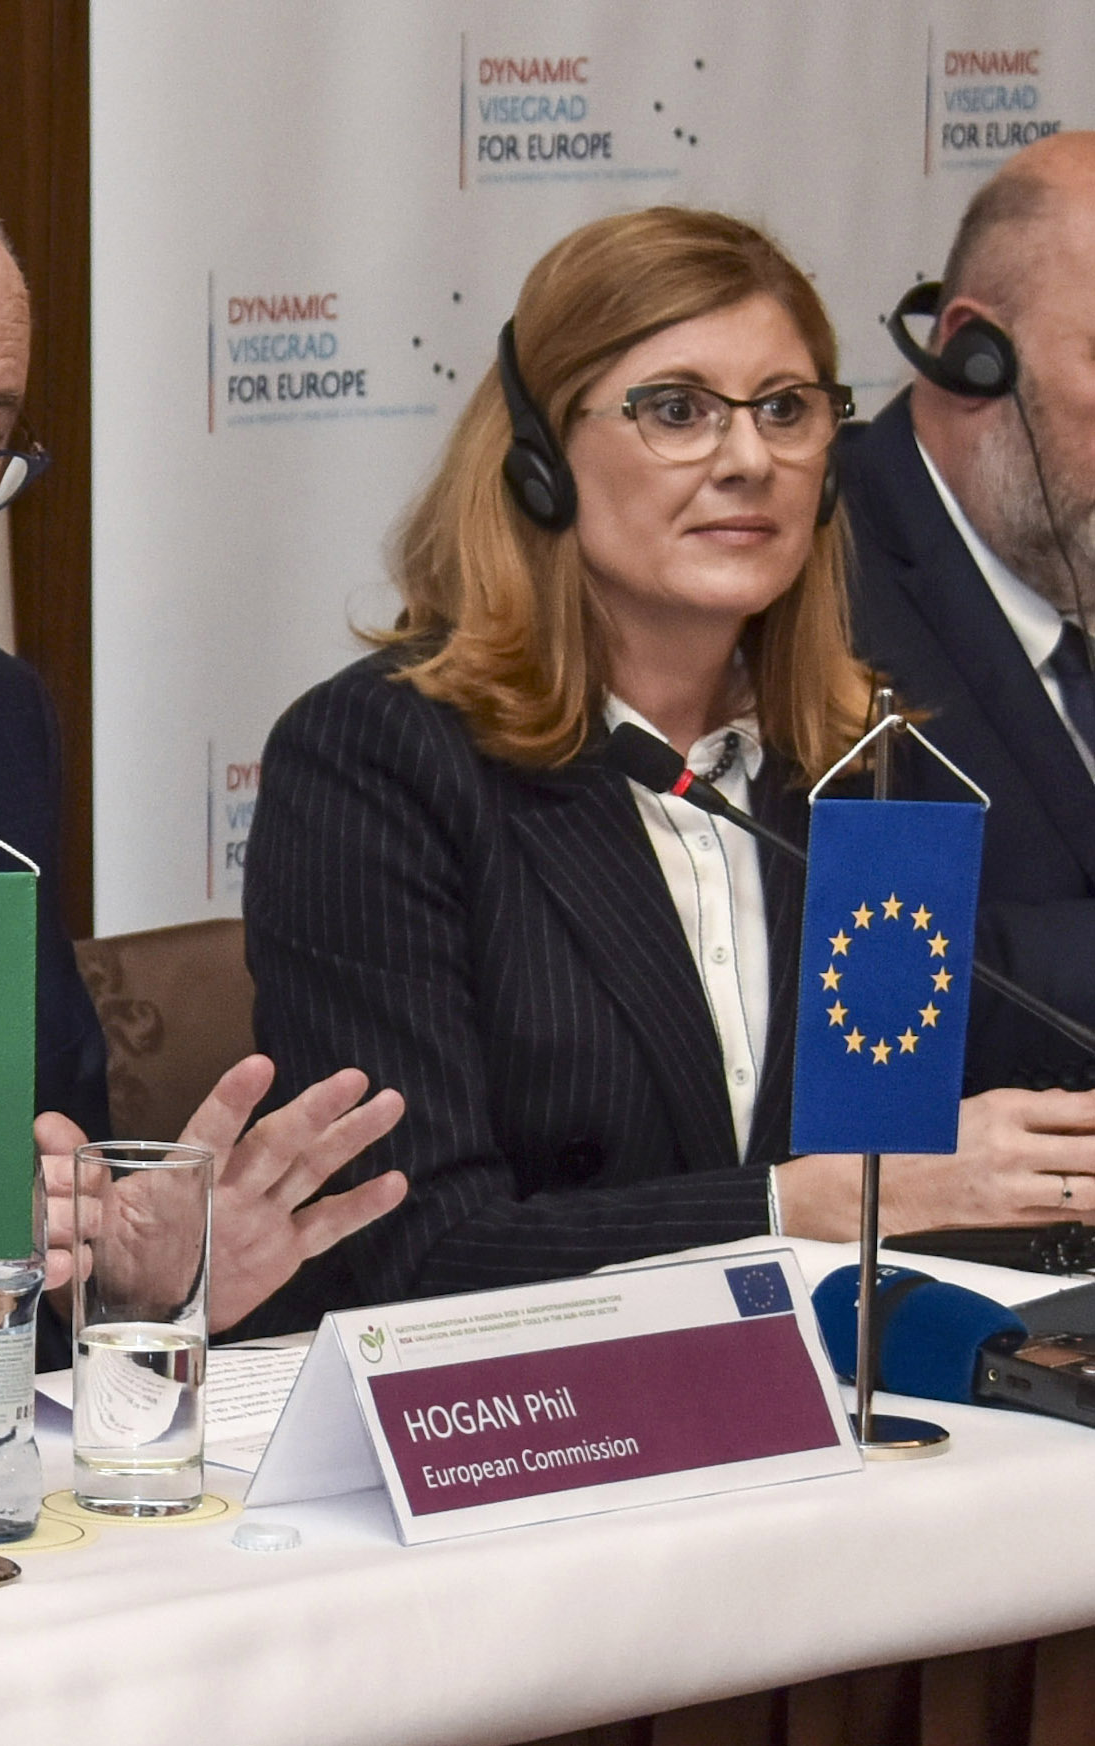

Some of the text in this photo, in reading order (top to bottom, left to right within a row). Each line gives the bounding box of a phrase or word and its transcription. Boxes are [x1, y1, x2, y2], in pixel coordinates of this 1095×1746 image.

[479, 57, 588, 84] DYNAMIC
[944, 50, 1040, 76] DYNAMIC
[478, 95, 587, 123] VISEGRAD
[944, 84, 1038, 112] VISEGRAD
[479, 131, 611, 161] FOR EUROPE
[942, 122, 979, 148] FOR
[228, 294, 337, 324] DYNAMIC
[228, 331, 337, 363] VISEGRAD
[228, 369, 366, 401] FOR EUROPE
[404, 1387, 577, 1443] HOGAN Phil
[422, 1435, 639, 1489] European Commission
